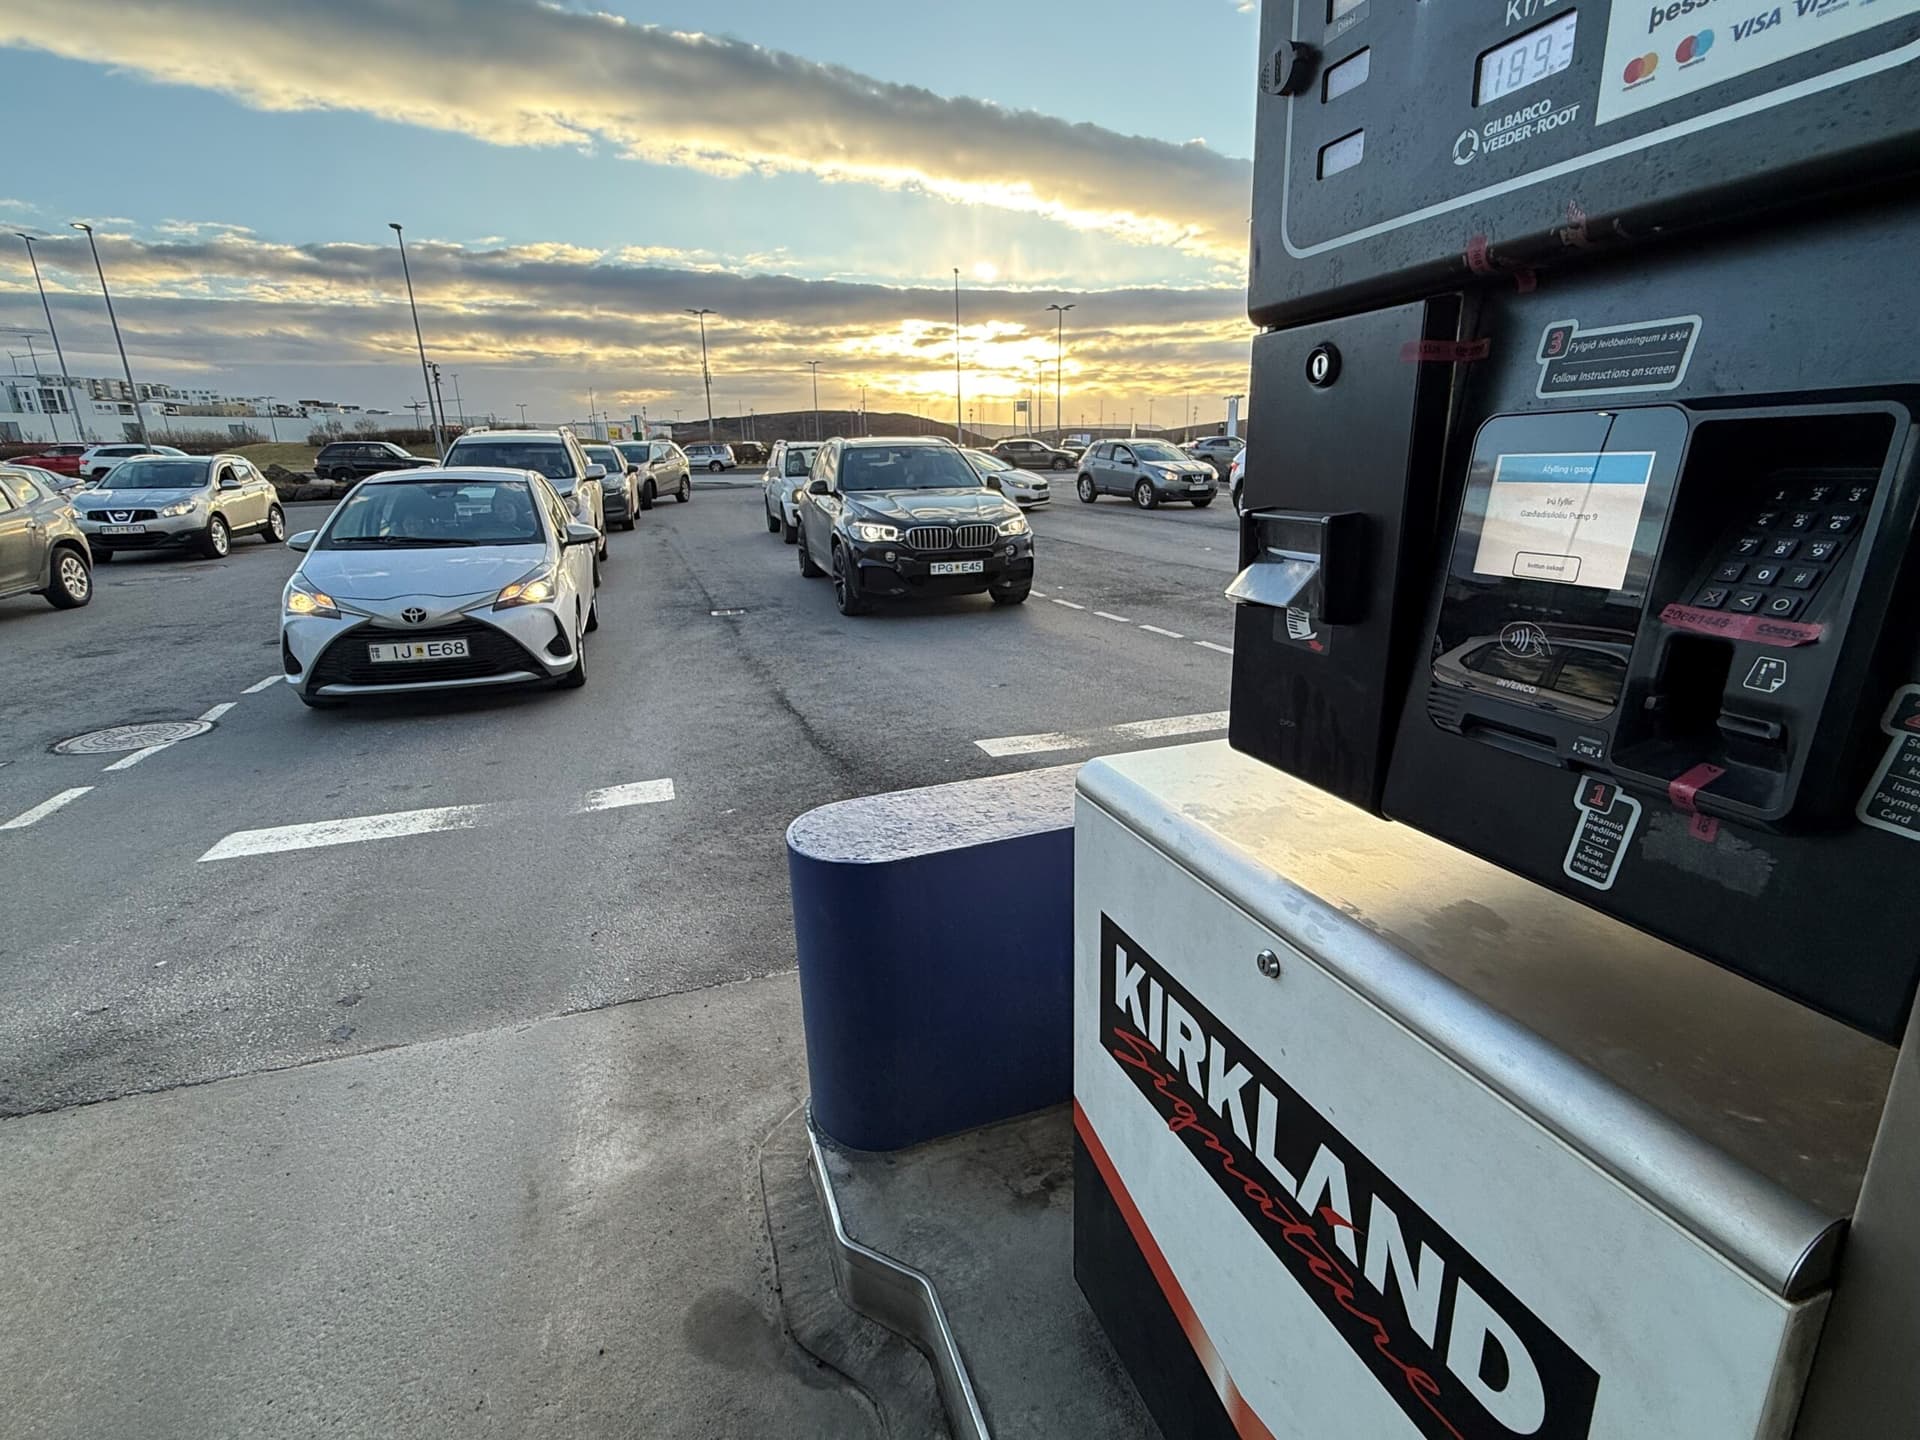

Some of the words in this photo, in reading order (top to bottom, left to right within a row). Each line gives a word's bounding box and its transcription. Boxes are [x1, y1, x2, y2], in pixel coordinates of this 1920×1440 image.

[1505, 0, 1557, 27] Kr/
[1794, 0, 1840, 17] VIS
[1731, 7, 1782, 42] VISA
[1483, 99, 1552, 137] GILBARCO
[1482, 105, 1581, 155] VEEDER-ROOT
[1548, 331, 1564, 354] 3
[1552, 373, 1577, 383] Follow
[1579, 367, 1630, 381] Instructions
[1632, 369, 1643, 377] on
[1644, 365, 1676, 377] screen
[1776, 491, 1785, 500] 1
[1810, 491, 1822, 501] 2
[1848, 492, 1861, 501] 3
[1592, 513, 1599, 521] 9
[1757, 517, 1767, 525] 4
[1793, 518, 1804, 528] 5
[1829, 520, 1841, 529] 6
[1739, 543, 1752, 552] 7
[1774, 545, 1785, 554] 8
[1812, 548, 1824, 557] 9
[938, 564, 953, 573] PG
[961, 562, 982, 572] E45
[1757, 569, 1769, 580] 0
[393, 644, 412, 659] IJ
[427, 641, 465, 657] E68
[1588, 784, 1606, 807] 1
[1891, 781, 1920, 798] Inse
[1880, 807, 1912, 825] Card
[1590, 832, 1609, 846] kort
[1583, 844, 1603, 859] Scan
[1576, 852, 1609, 870] Member
[1572, 860, 1588, 872] ship
[1588, 866, 1607, 880] Card
[1115, 944, 1546, 1436] KIRKLAND
[1113, 1027, 1466, 1440] Signature
